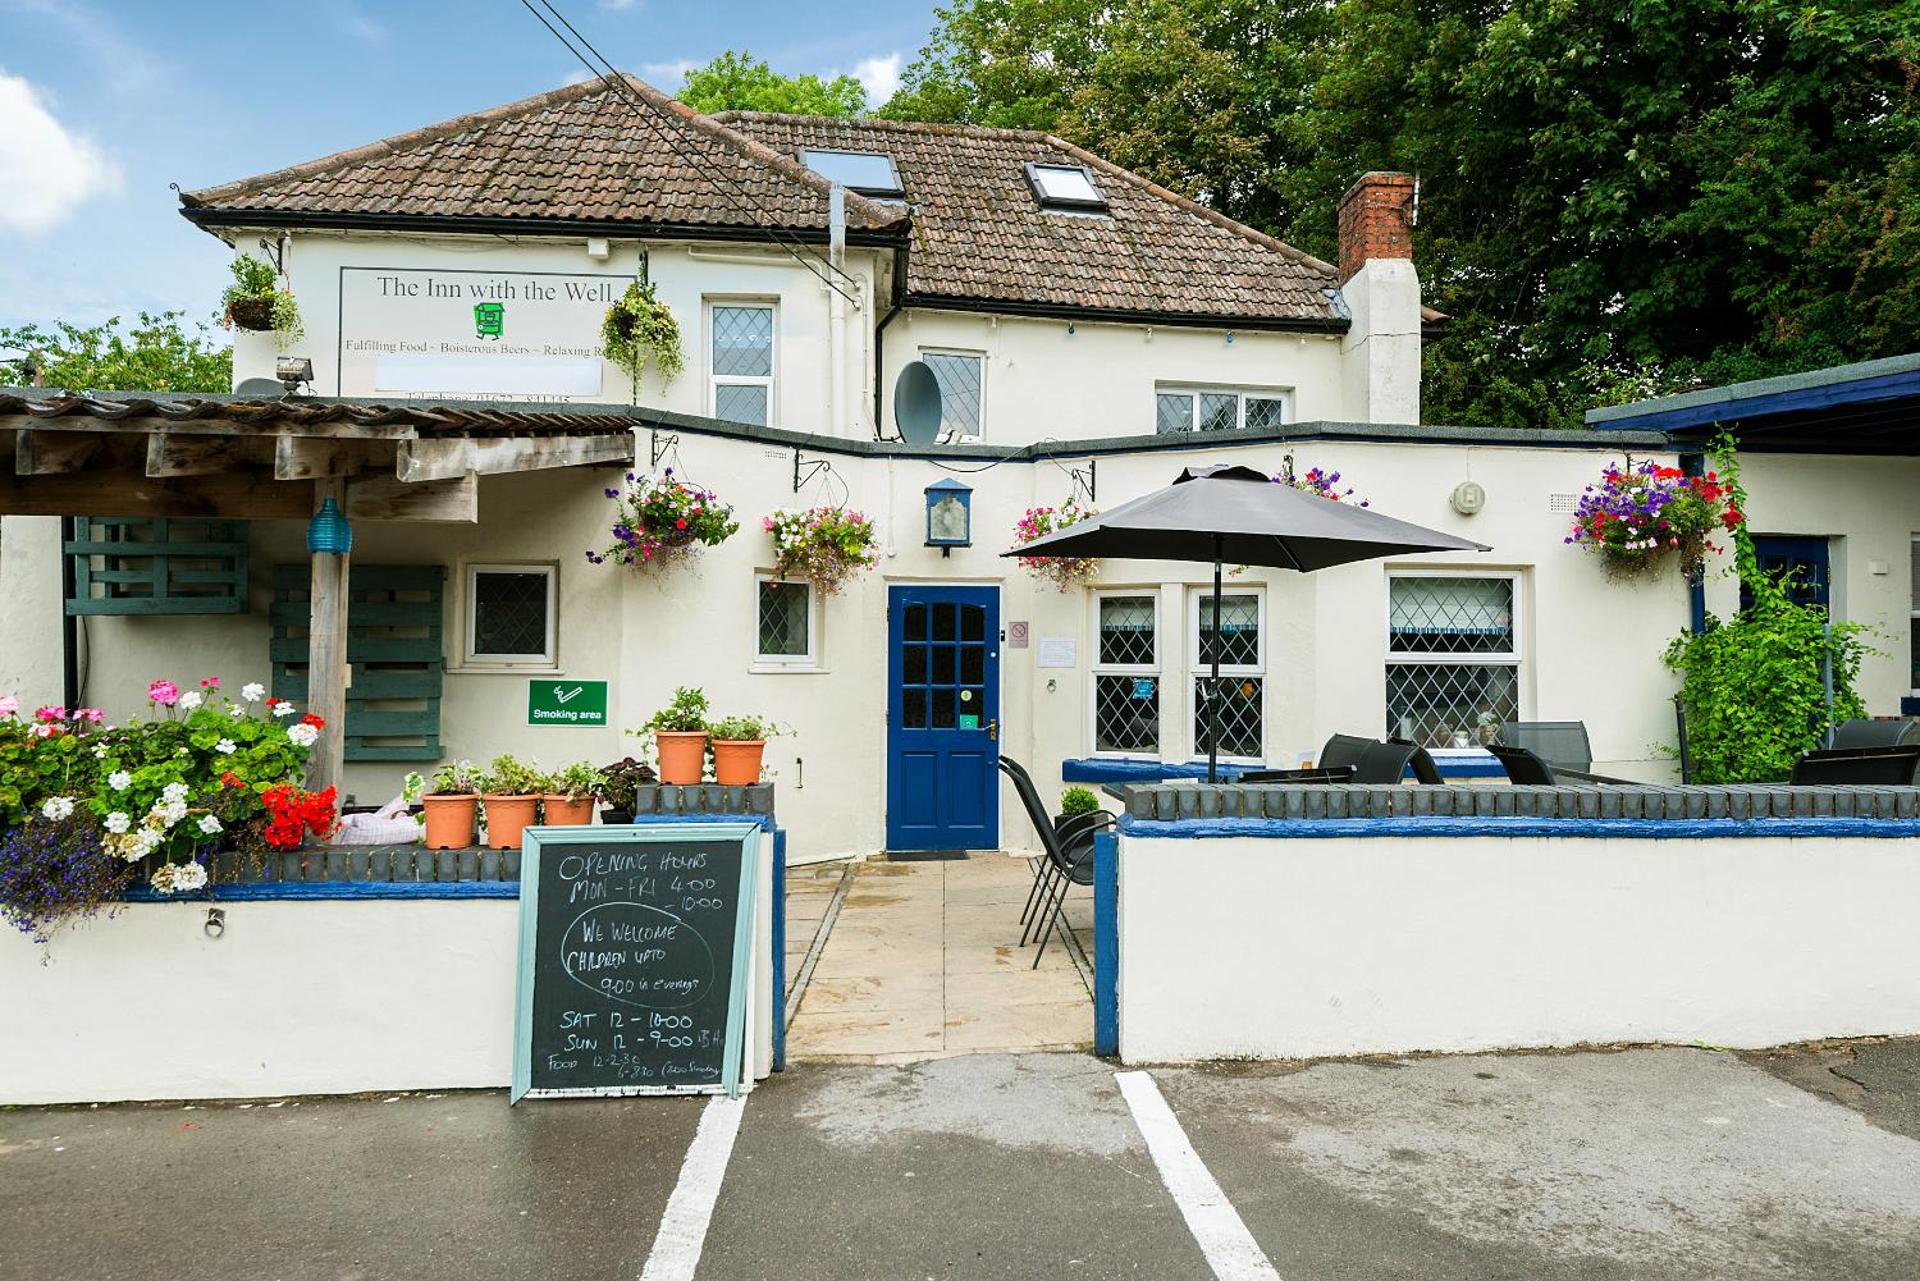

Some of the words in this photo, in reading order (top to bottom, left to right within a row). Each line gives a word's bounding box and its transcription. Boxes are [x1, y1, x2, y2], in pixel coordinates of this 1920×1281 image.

[377, 277, 418, 297] The
[428, 278, 461, 298] Inn
[468, 279, 516, 299] with
[525, 281, 556, 301] the
[564, 282, 611, 303] Well
[400, 341, 427, 352] Food
[440, 342, 497, 354] Boisterous
[500, 344, 530, 354] Beers
[543, 344, 590, 358] Relaxing
[533, 709, 578, 721] Smoking
[579, 711, 602, 720] area
[559, 852, 648, 880] OPENING
[659, 852, 708, 871] HOURS
[570, 878, 608, 903] MON
[627, 876, 656, 899] FRI
[583, 918, 604, 942] WE
[611, 921, 679, 943] WELCOME
[567, 951, 627, 974] CHILDREN
[560, 1011, 597, 1029] SAT
[610, 1012, 624, 1028] 12
[564, 1034, 598, 1052] SUN
